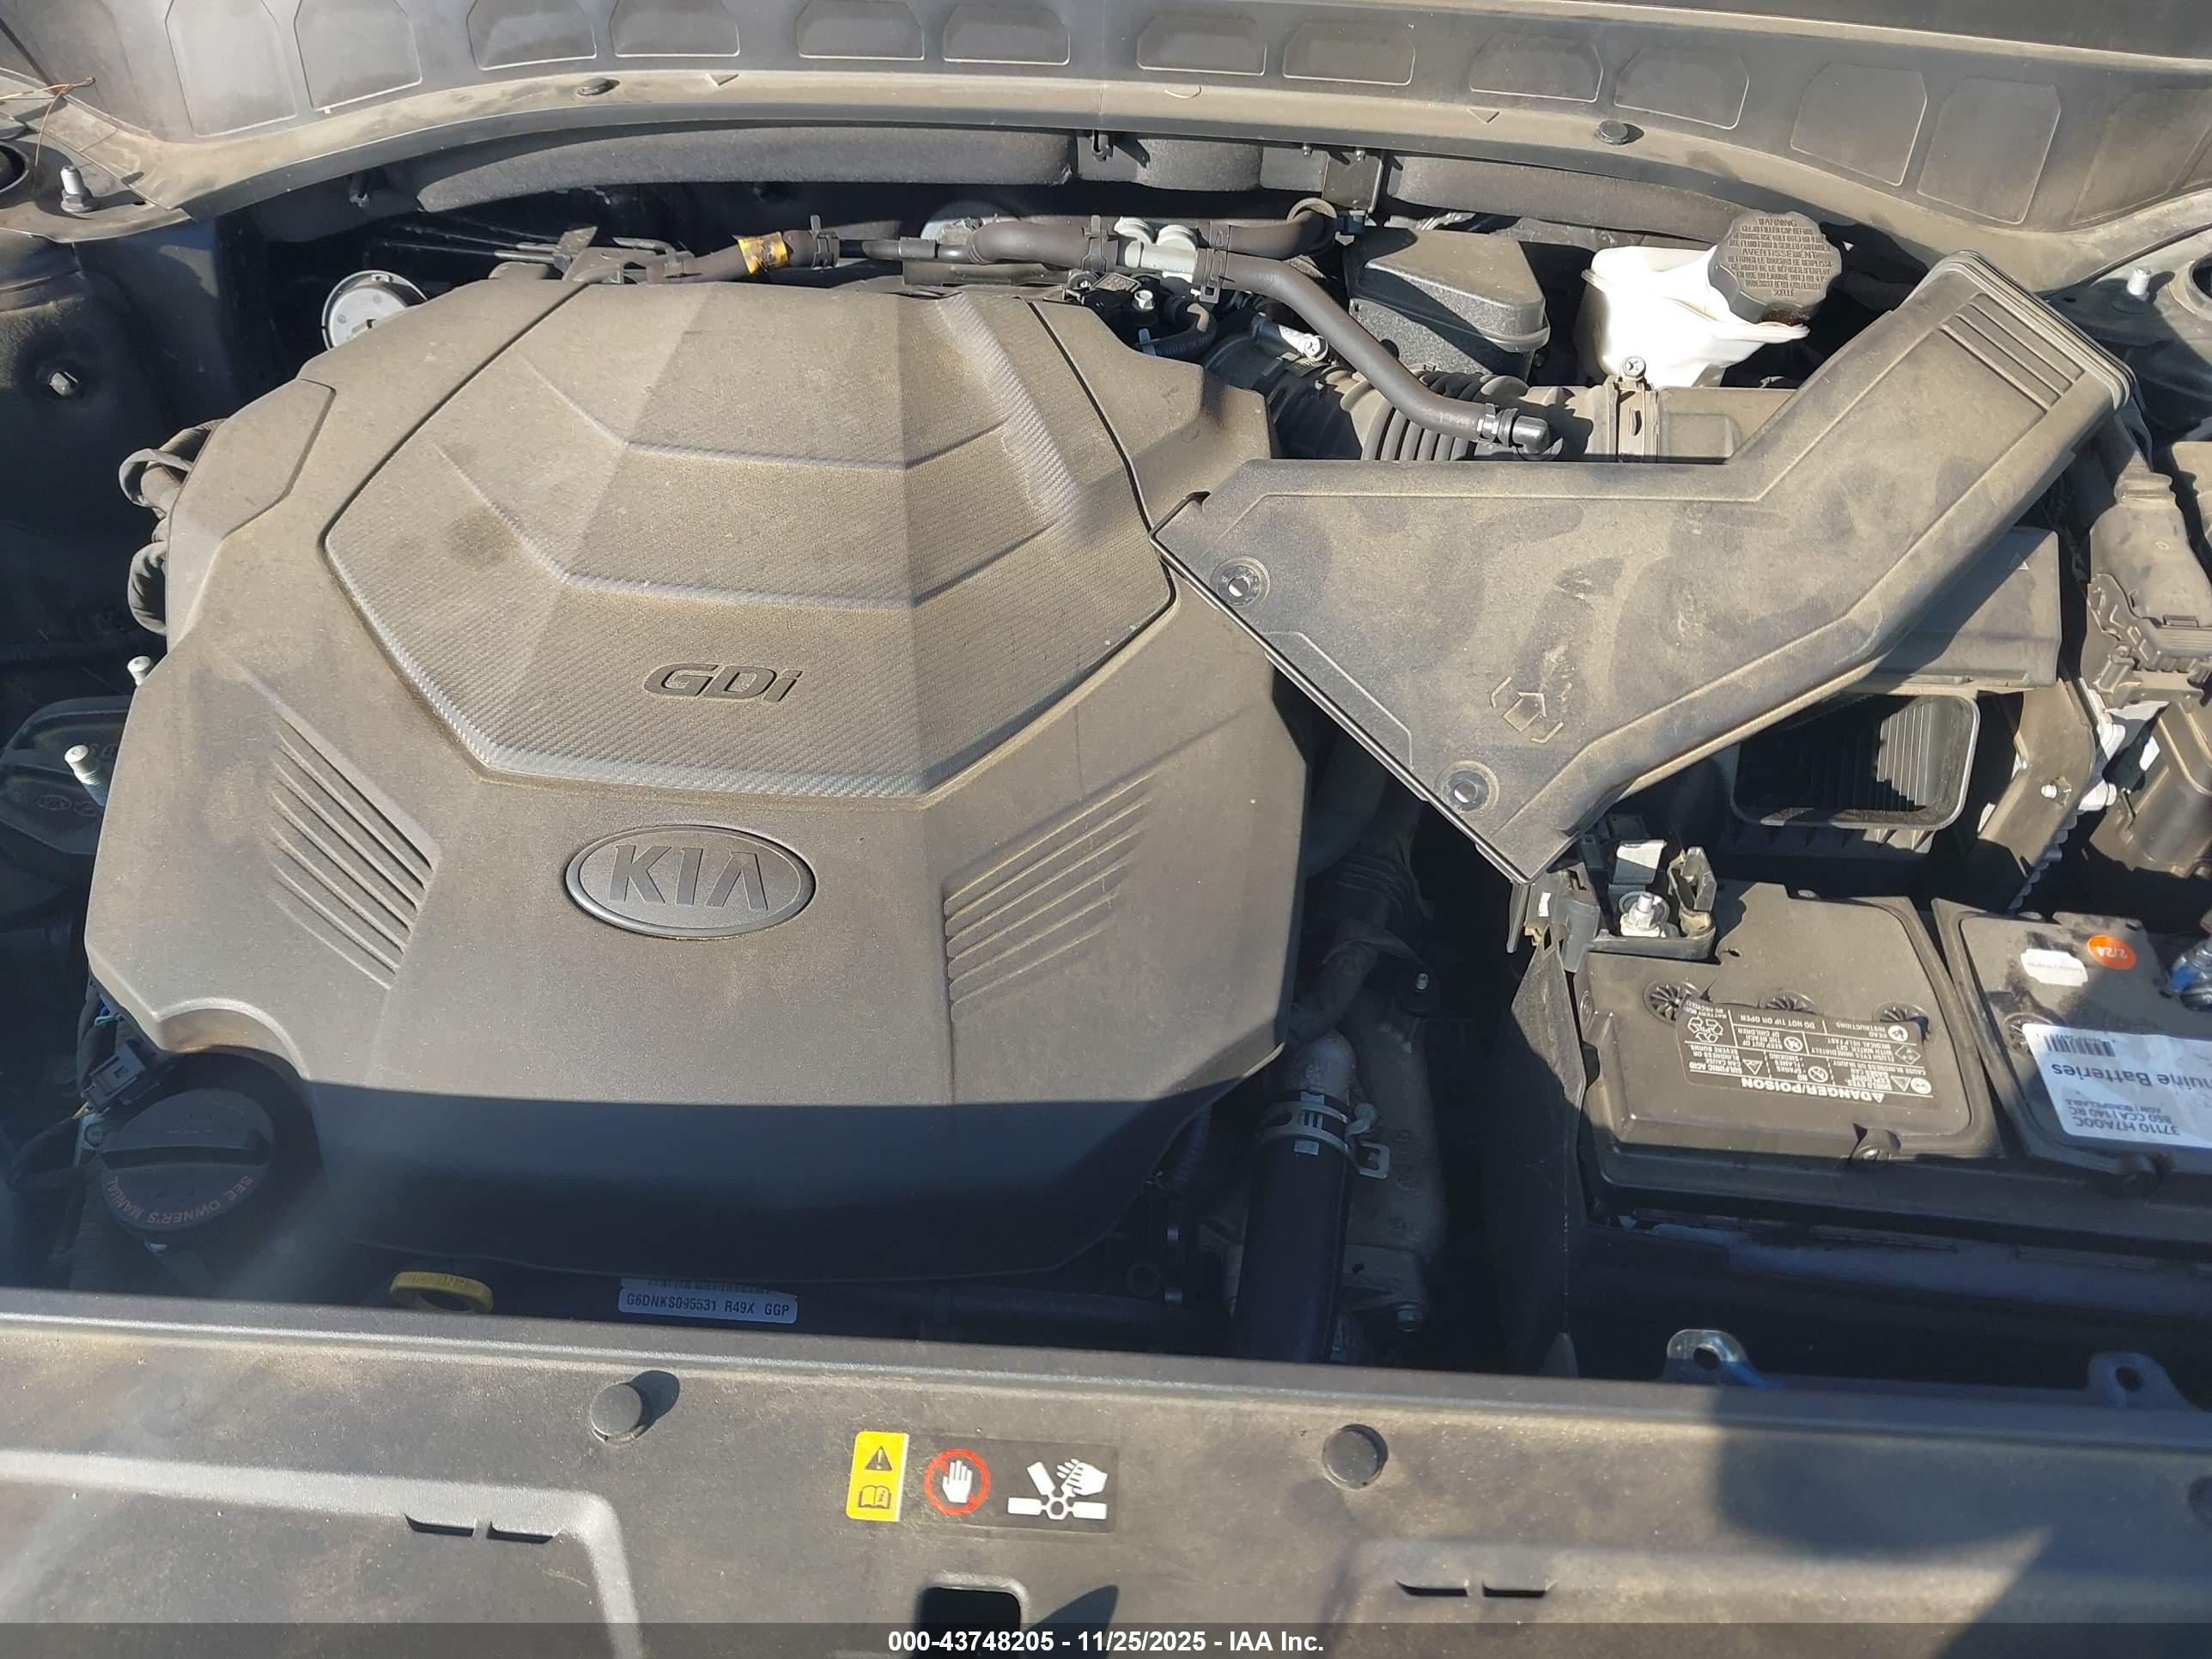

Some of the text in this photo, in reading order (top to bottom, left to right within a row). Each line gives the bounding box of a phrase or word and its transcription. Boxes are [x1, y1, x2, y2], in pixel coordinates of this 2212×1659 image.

[1741, 249, 1816, 258] AVERTISSEMENT
[643, 663, 803, 702] GDi
[609, 845, 768, 910] KIA
[1746, 1034, 1767, 1042] REACH
[1862, 1041, 1890, 1049] MEDICAL
[1714, 1047, 1738, 1055] SEVERE
[1811, 1048, 1855, 1058] IMMEDIATELY
[1704, 1052, 1740, 1061] BLINDNESS
[1769, 1053, 1800, 1061] SMOKING
[1873, 1054, 1894, 1063] FLUSH
[1689, 1061, 1743, 1073] SULFURIC ACID
[1868, 1065, 1904, 1073] BLINDNESS
[1865, 1070, 1888, 1079] GASES
[2051, 1063, 2152, 1087] Batteries
[1851, 1075, 1889, 1084] EXPLOSIVE
[1741, 1077, 1872, 1101] DANGER/POISON
[1867, 1082, 1892, 1091] SHIELD
[2068, 1107, 2087, 1116] RC
[2088, 1109, 2112, 1118] 140
[2119, 1111, 2147, 1121] CCA
[2148, 1115, 2172, 1124] 850
[2073, 1116, 2180, 1135] 37110 H7A00C
[106, 1175, 253, 1224] SEE OWNER'S MANUAL
[627, 1292, 790, 1316] G6DNKS095531 R49X GGP
